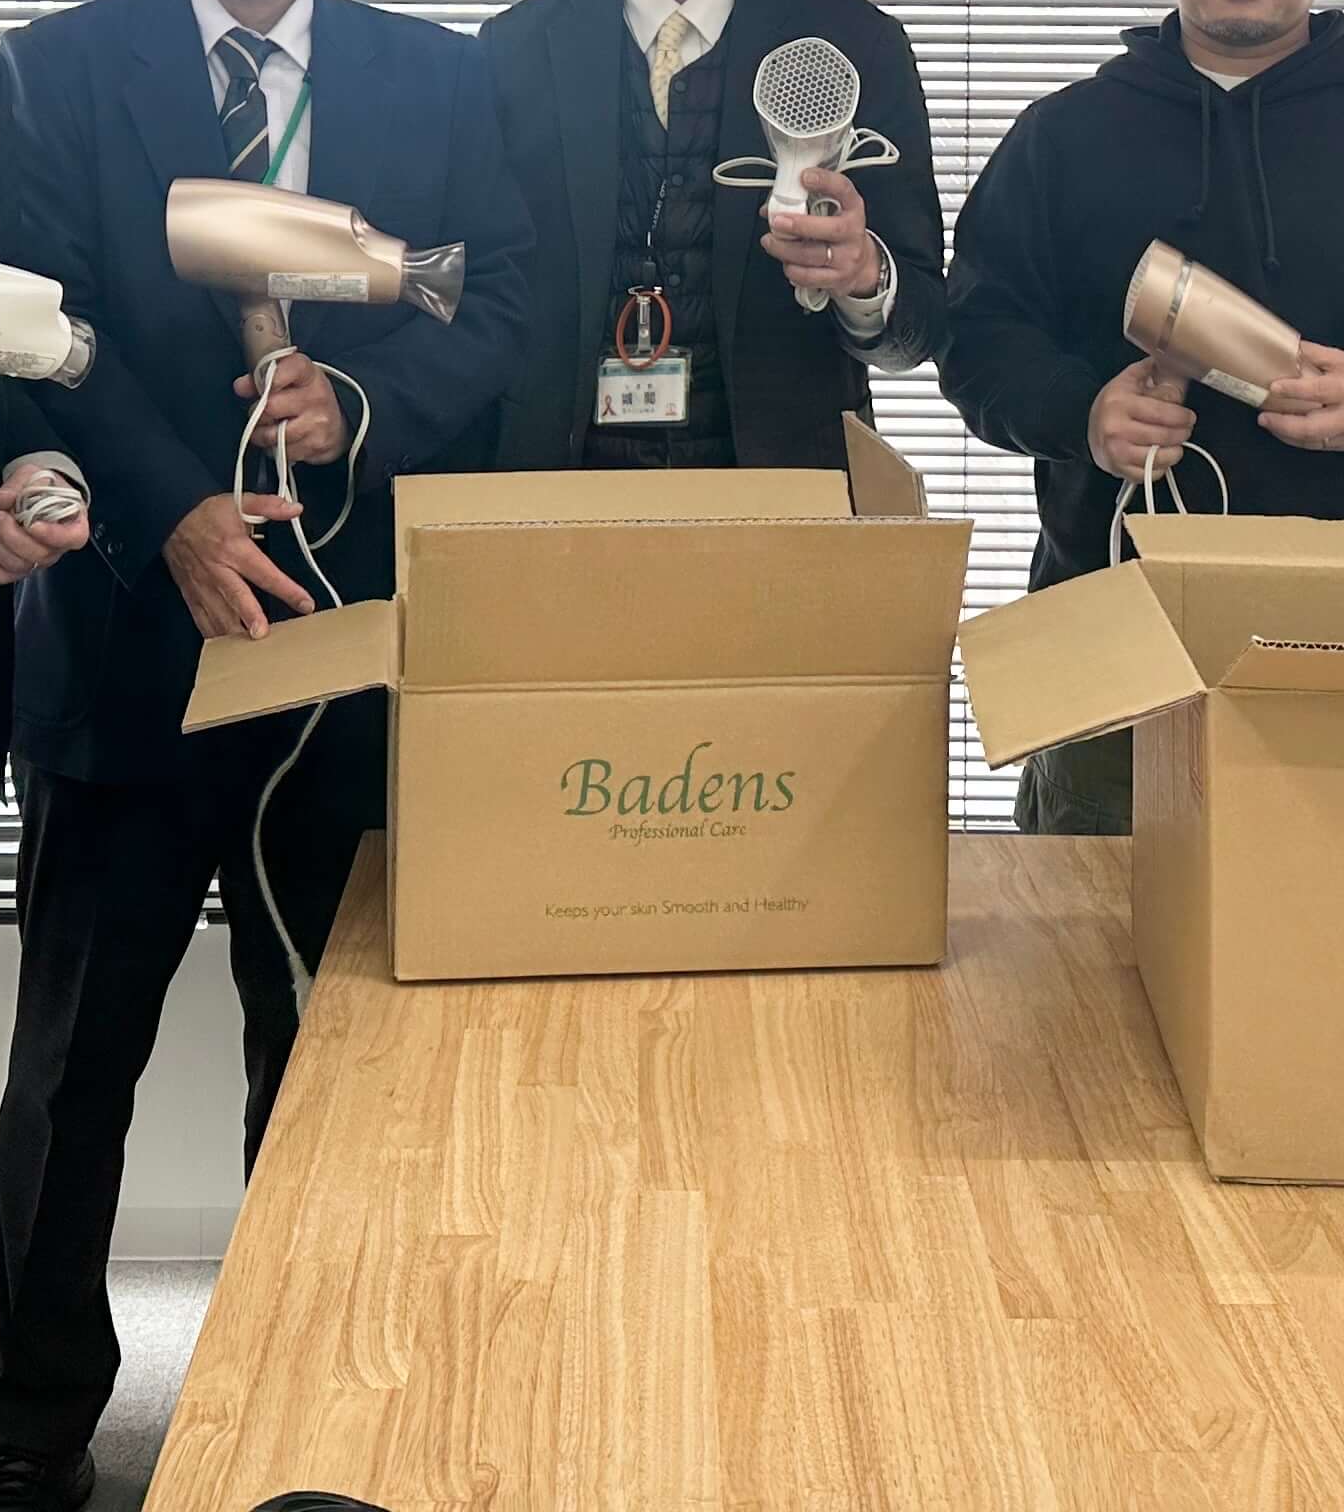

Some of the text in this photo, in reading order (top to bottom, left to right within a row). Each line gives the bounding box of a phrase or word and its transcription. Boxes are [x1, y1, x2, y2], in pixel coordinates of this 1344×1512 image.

[560, 741, 796, 816] Badens
[609, 819, 747, 847] Professional Care
[544, 896, 809, 920] Keeps your skin Smooth and Healthy
